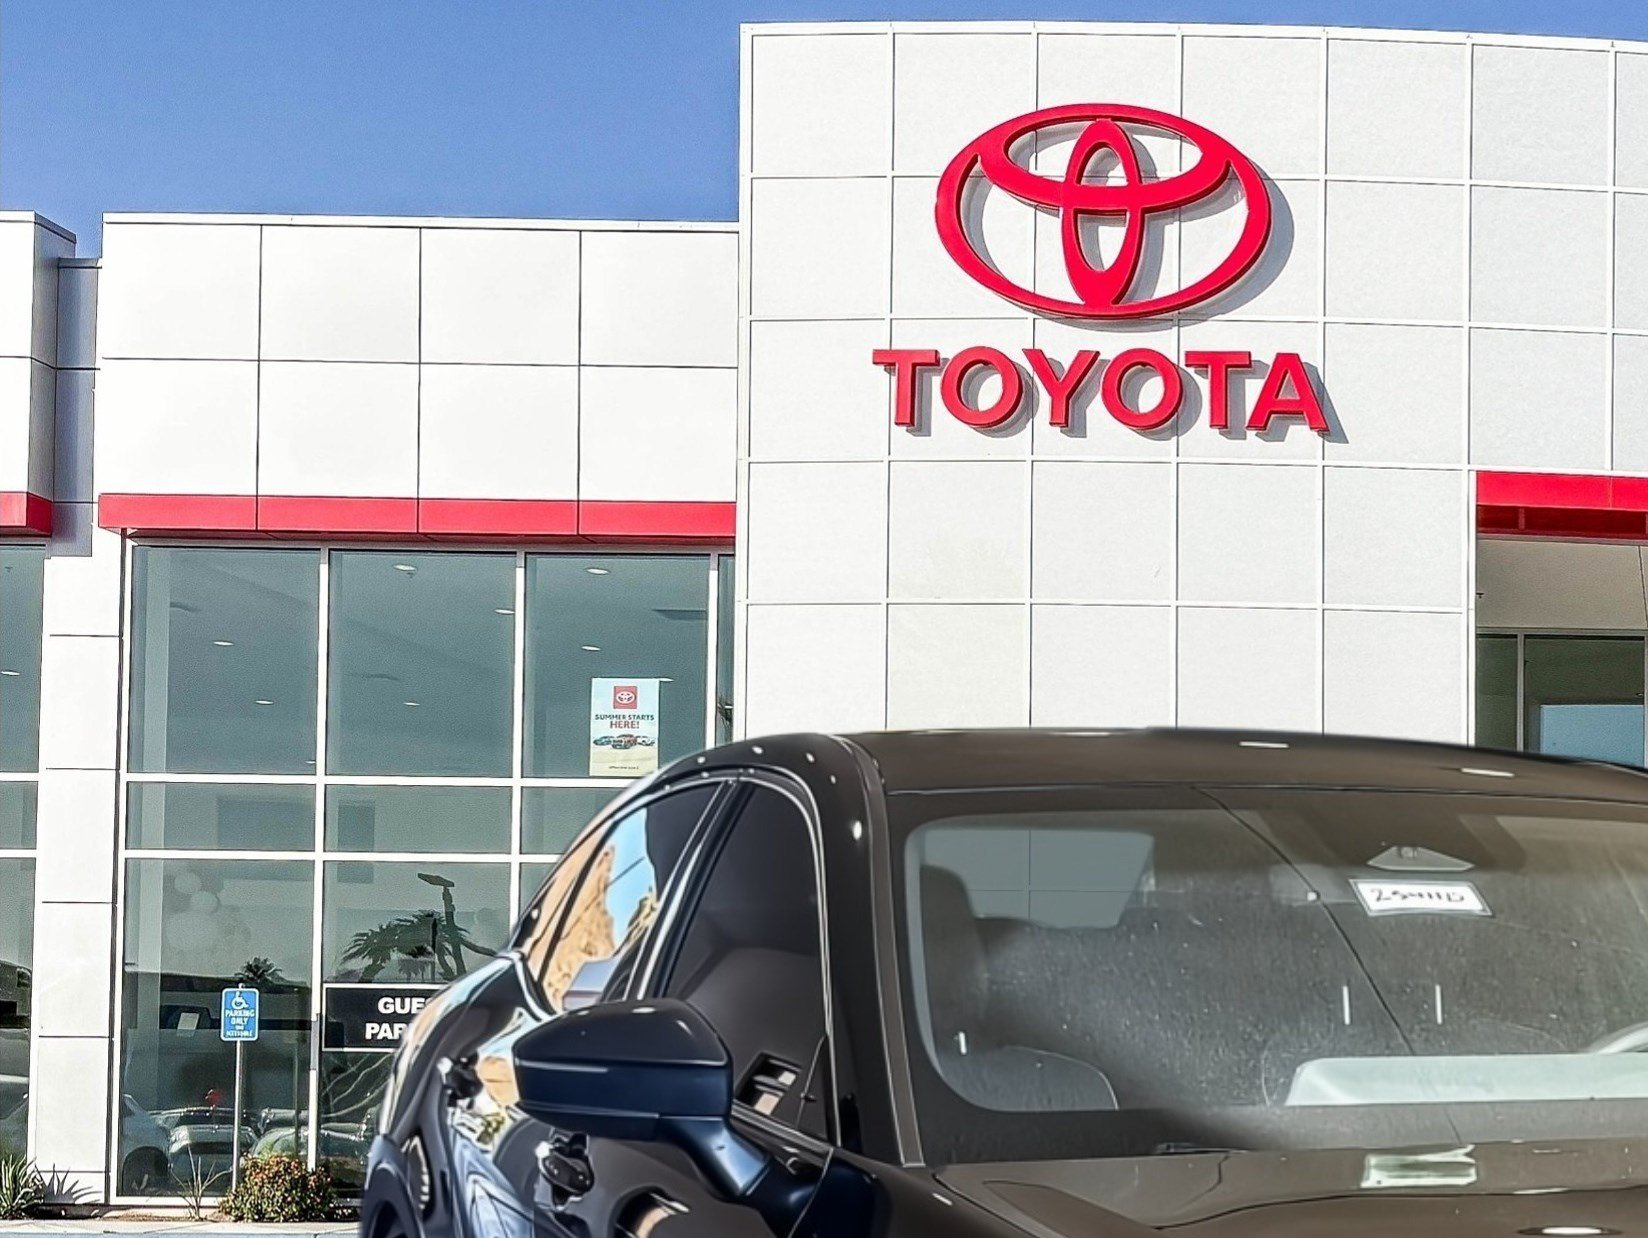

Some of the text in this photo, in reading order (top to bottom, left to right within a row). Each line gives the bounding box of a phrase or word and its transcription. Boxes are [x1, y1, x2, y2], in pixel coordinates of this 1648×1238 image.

[872, 346, 1330, 432] TOYOTA
[609, 720, 640, 729] HERE!
[378, 997, 431, 1014] GUE
